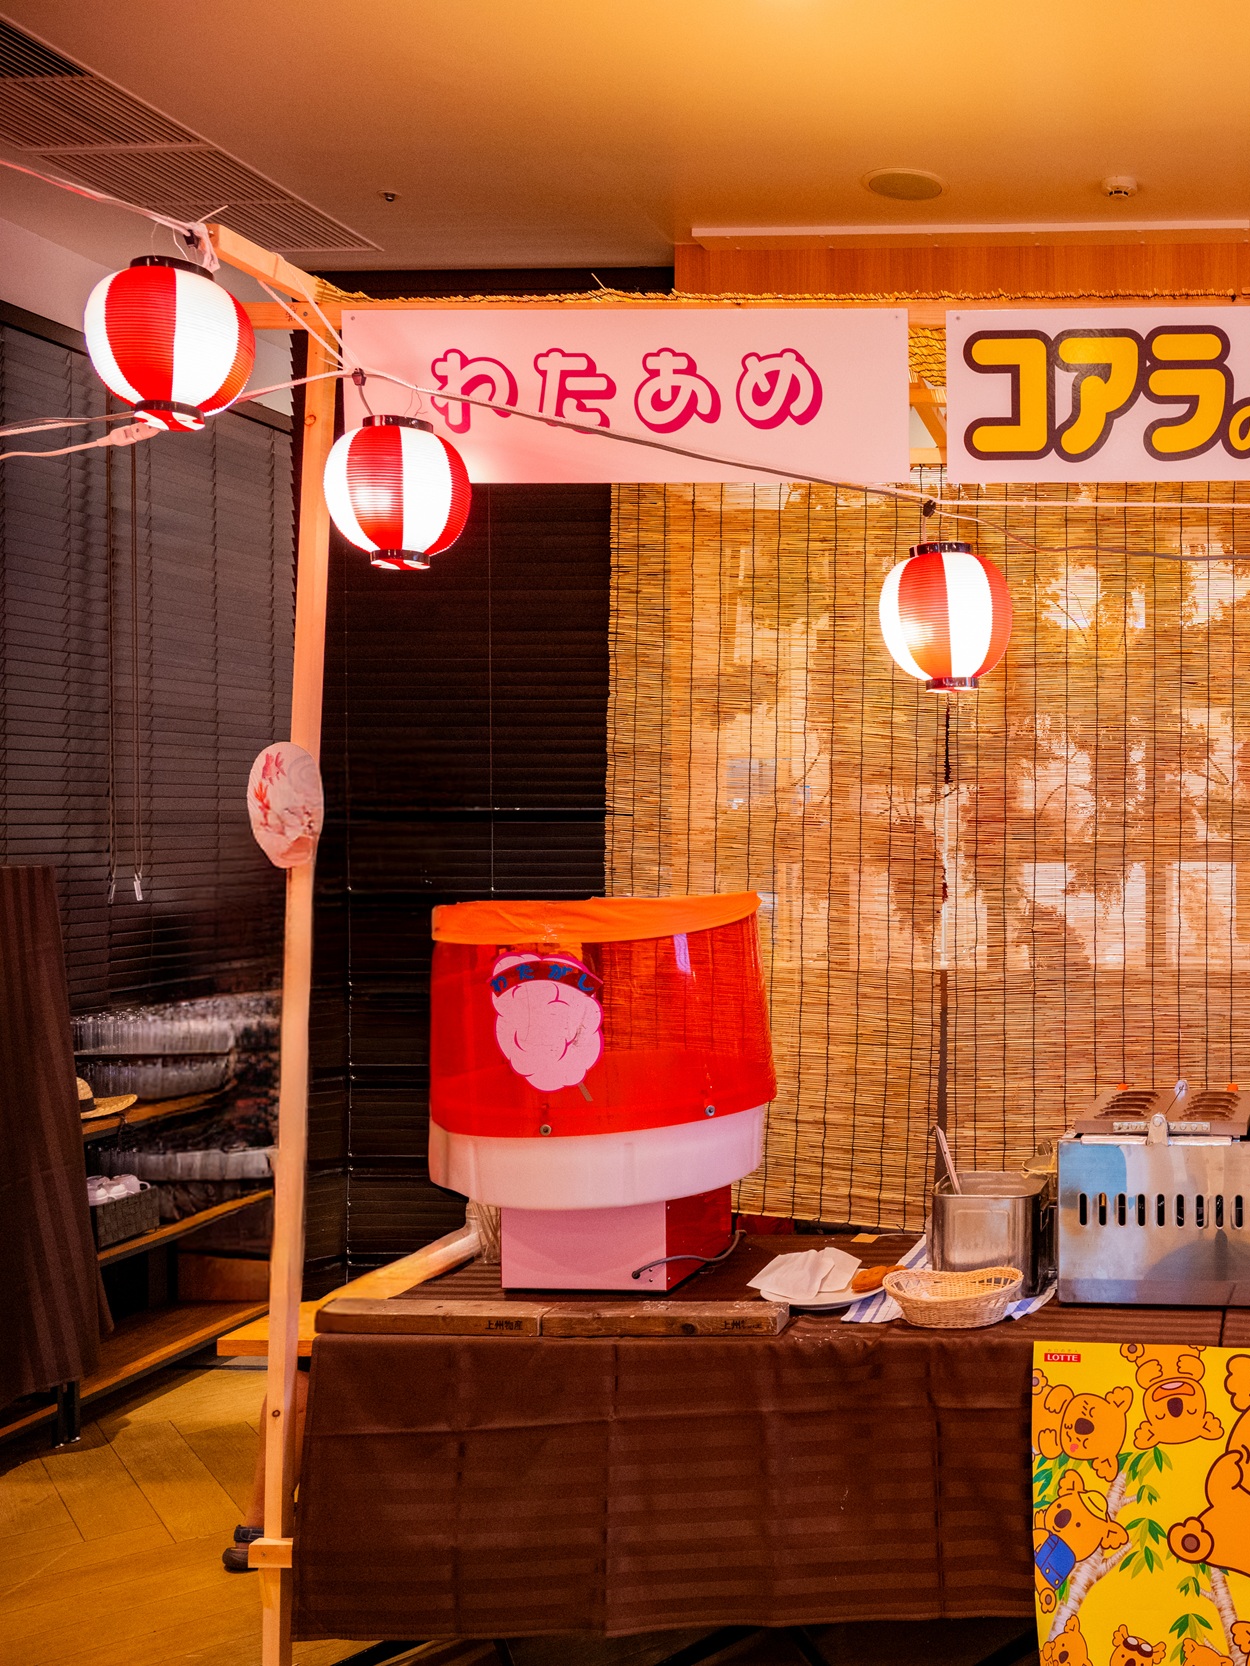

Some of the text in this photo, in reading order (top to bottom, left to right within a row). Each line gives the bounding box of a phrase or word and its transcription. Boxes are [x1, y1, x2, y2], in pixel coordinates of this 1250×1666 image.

[430, 347, 823, 434] わたあめ
[490, 964, 594, 992] わたがし
